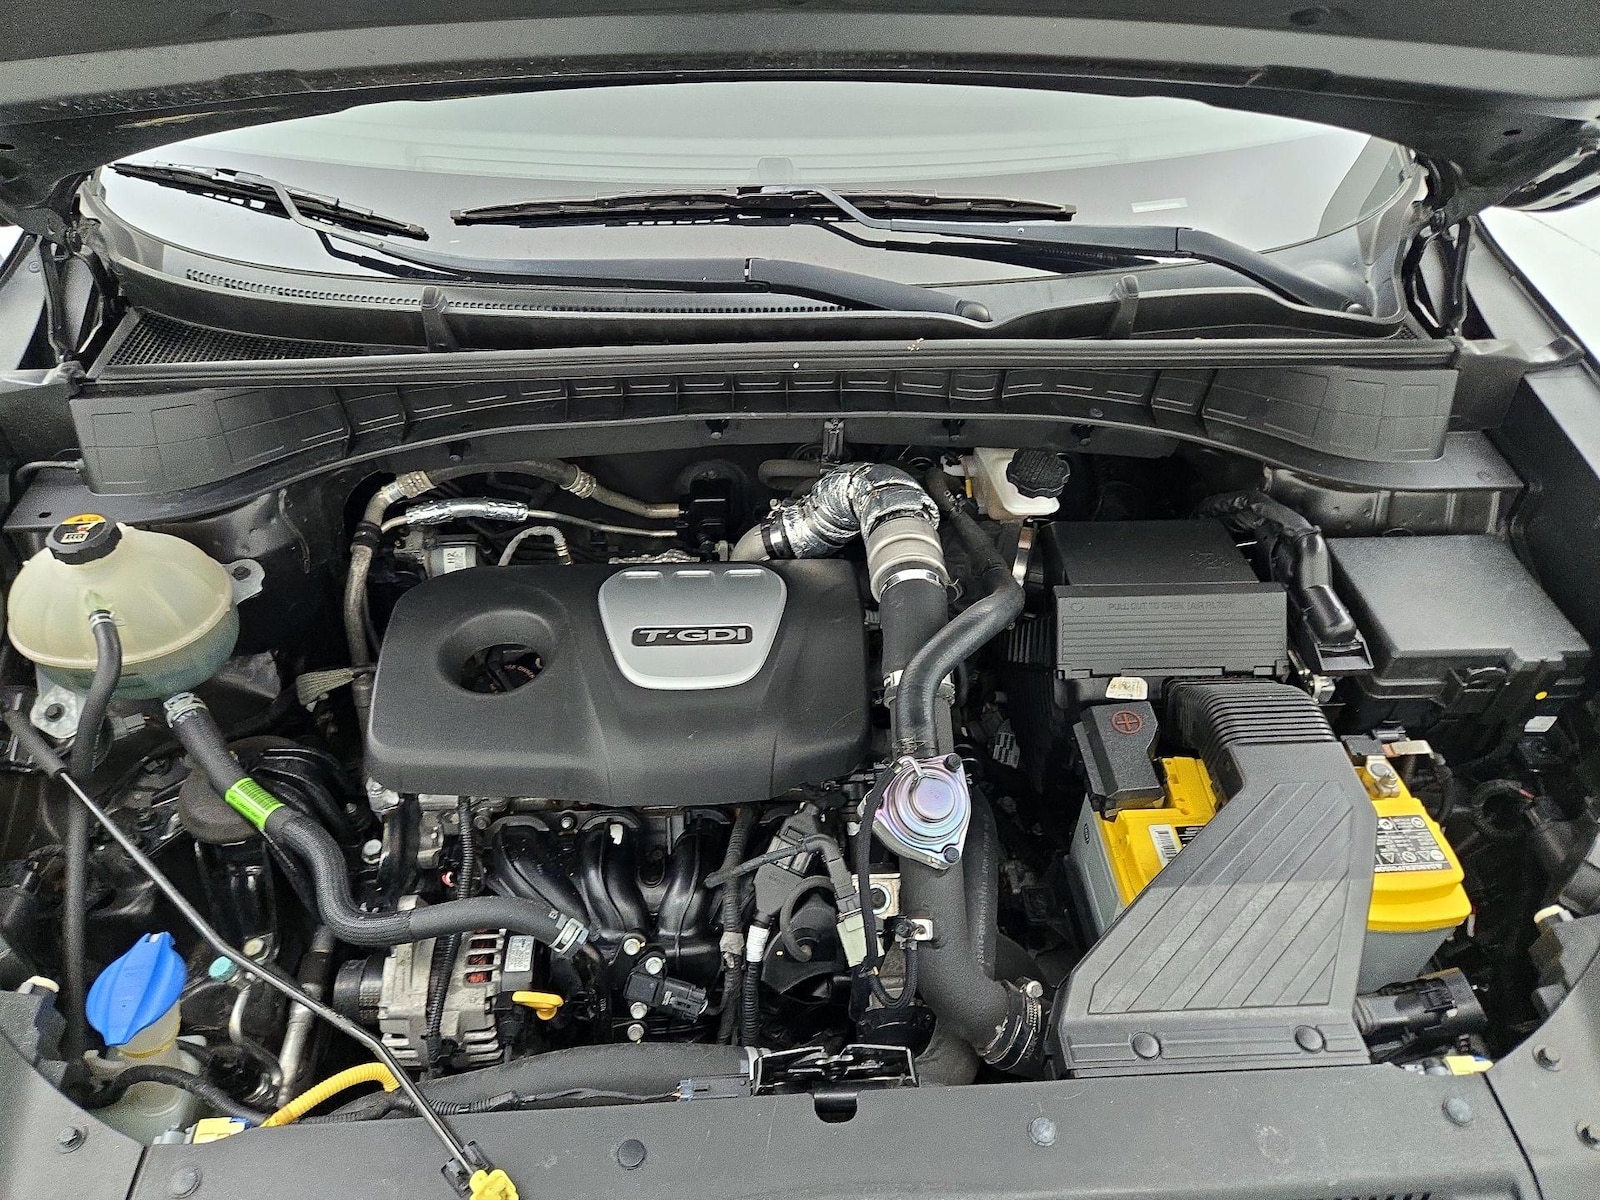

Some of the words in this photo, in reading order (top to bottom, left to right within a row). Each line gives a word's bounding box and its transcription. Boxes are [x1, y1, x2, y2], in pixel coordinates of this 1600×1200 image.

[1108, 602, 1129, 610] PULL
[1130, 602, 1147, 610] OUT
[1161, 601, 1183, 609] OPEN
[639, 628, 747, 643] T-GDI
